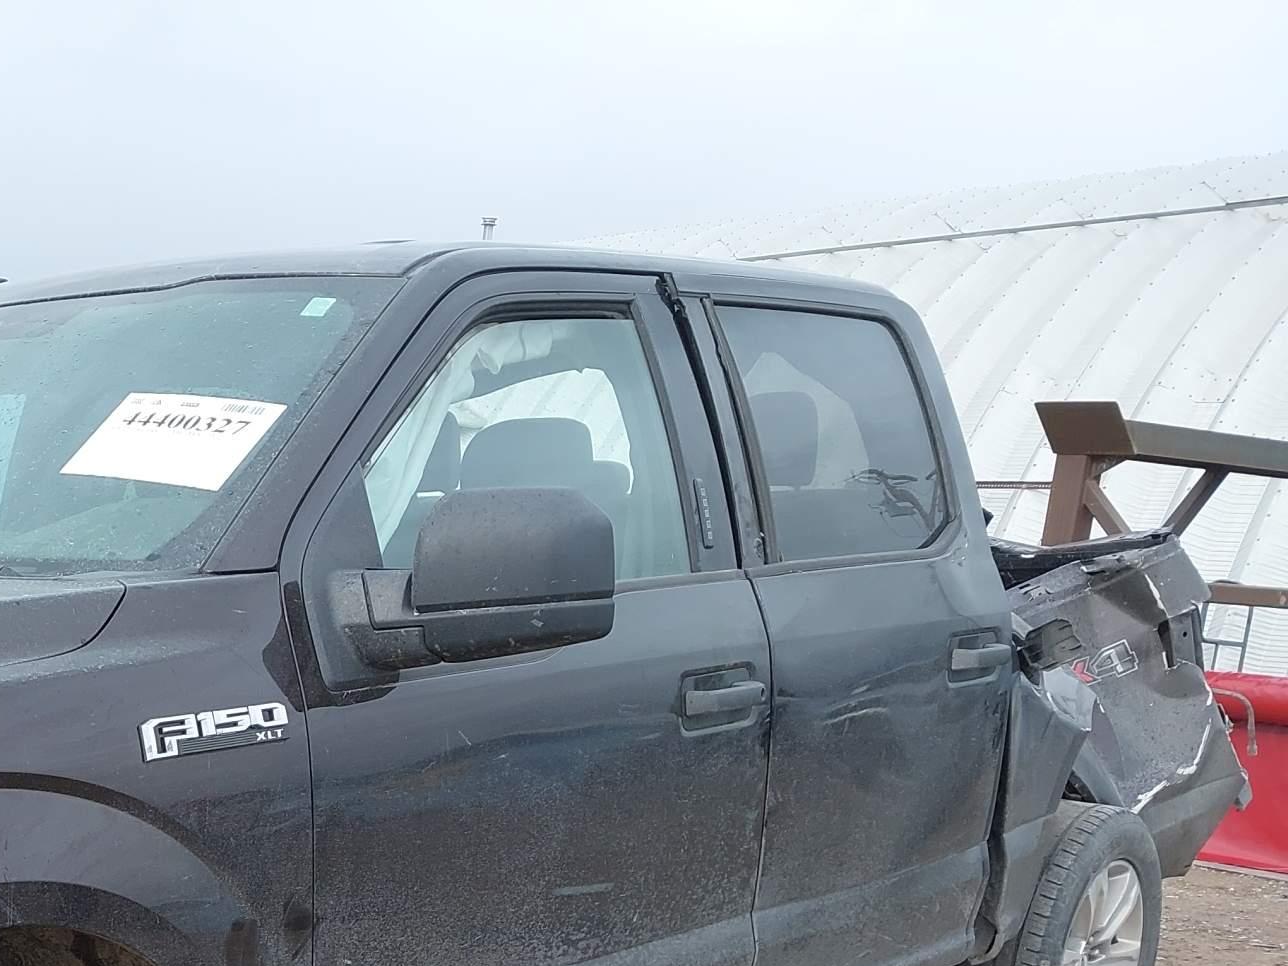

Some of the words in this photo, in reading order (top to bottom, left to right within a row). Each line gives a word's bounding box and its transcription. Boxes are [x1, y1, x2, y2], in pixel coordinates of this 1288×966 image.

[123, 411, 252, 435] 44400327
[140, 702, 289, 762] F150
[255, 728, 284, 742] XLT
